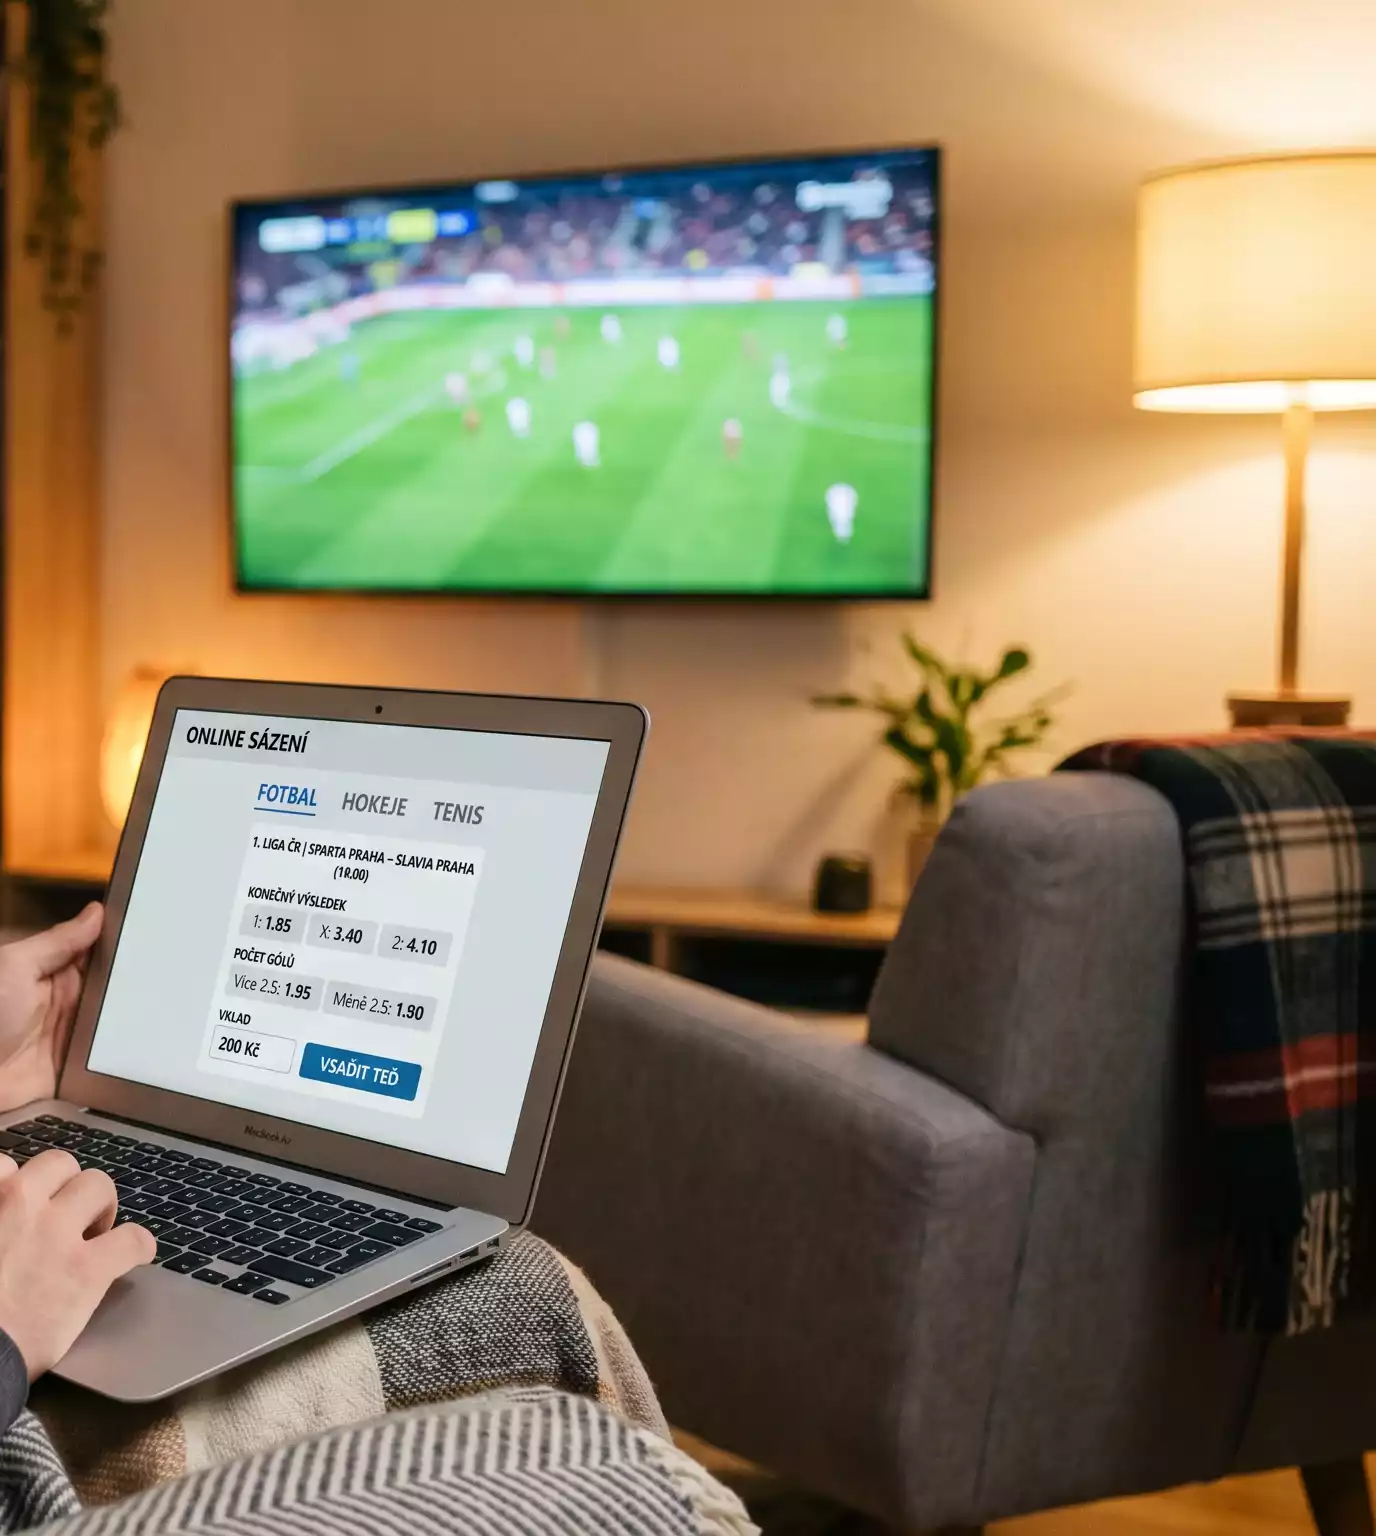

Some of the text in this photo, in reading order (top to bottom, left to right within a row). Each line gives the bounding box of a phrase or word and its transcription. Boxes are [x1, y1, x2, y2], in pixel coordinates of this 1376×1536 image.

[186, 726, 310, 753] ONLINE SÁZENÍ
[257, 783, 317, 807] FOTBAL
[342, 792, 408, 817] HOKEJE
[433, 801, 484, 825] TENIS
[253, 836, 260, 848] 1.
[263, 837, 285, 851] LIGA
[287, 837, 301, 853] ČR
[308, 843, 346, 859] SPARTA
[348, 847, 385, 864] PRAHA
[395, 854, 433, 870] SLAVIA
[436, 858, 474, 875] PRAHA
[248, 886, 347, 911] KONEČNÝ VÝSLEDEK
[254, 914, 292, 933] 1: 1.85
[319, 924, 363, 944] X: 3.40
[391, 935, 438, 956] 2: 4.10
[259, 978, 281, 995] 2.5:
[285, 982, 312, 1000] 1.95
[219, 1009, 251, 1026] VKLAD
[369, 998, 392, 1015] 2.5:
[218, 1037, 261, 1058] 200 Kč
[321, 1056, 399, 1087] VSAĎIT TEĎ
